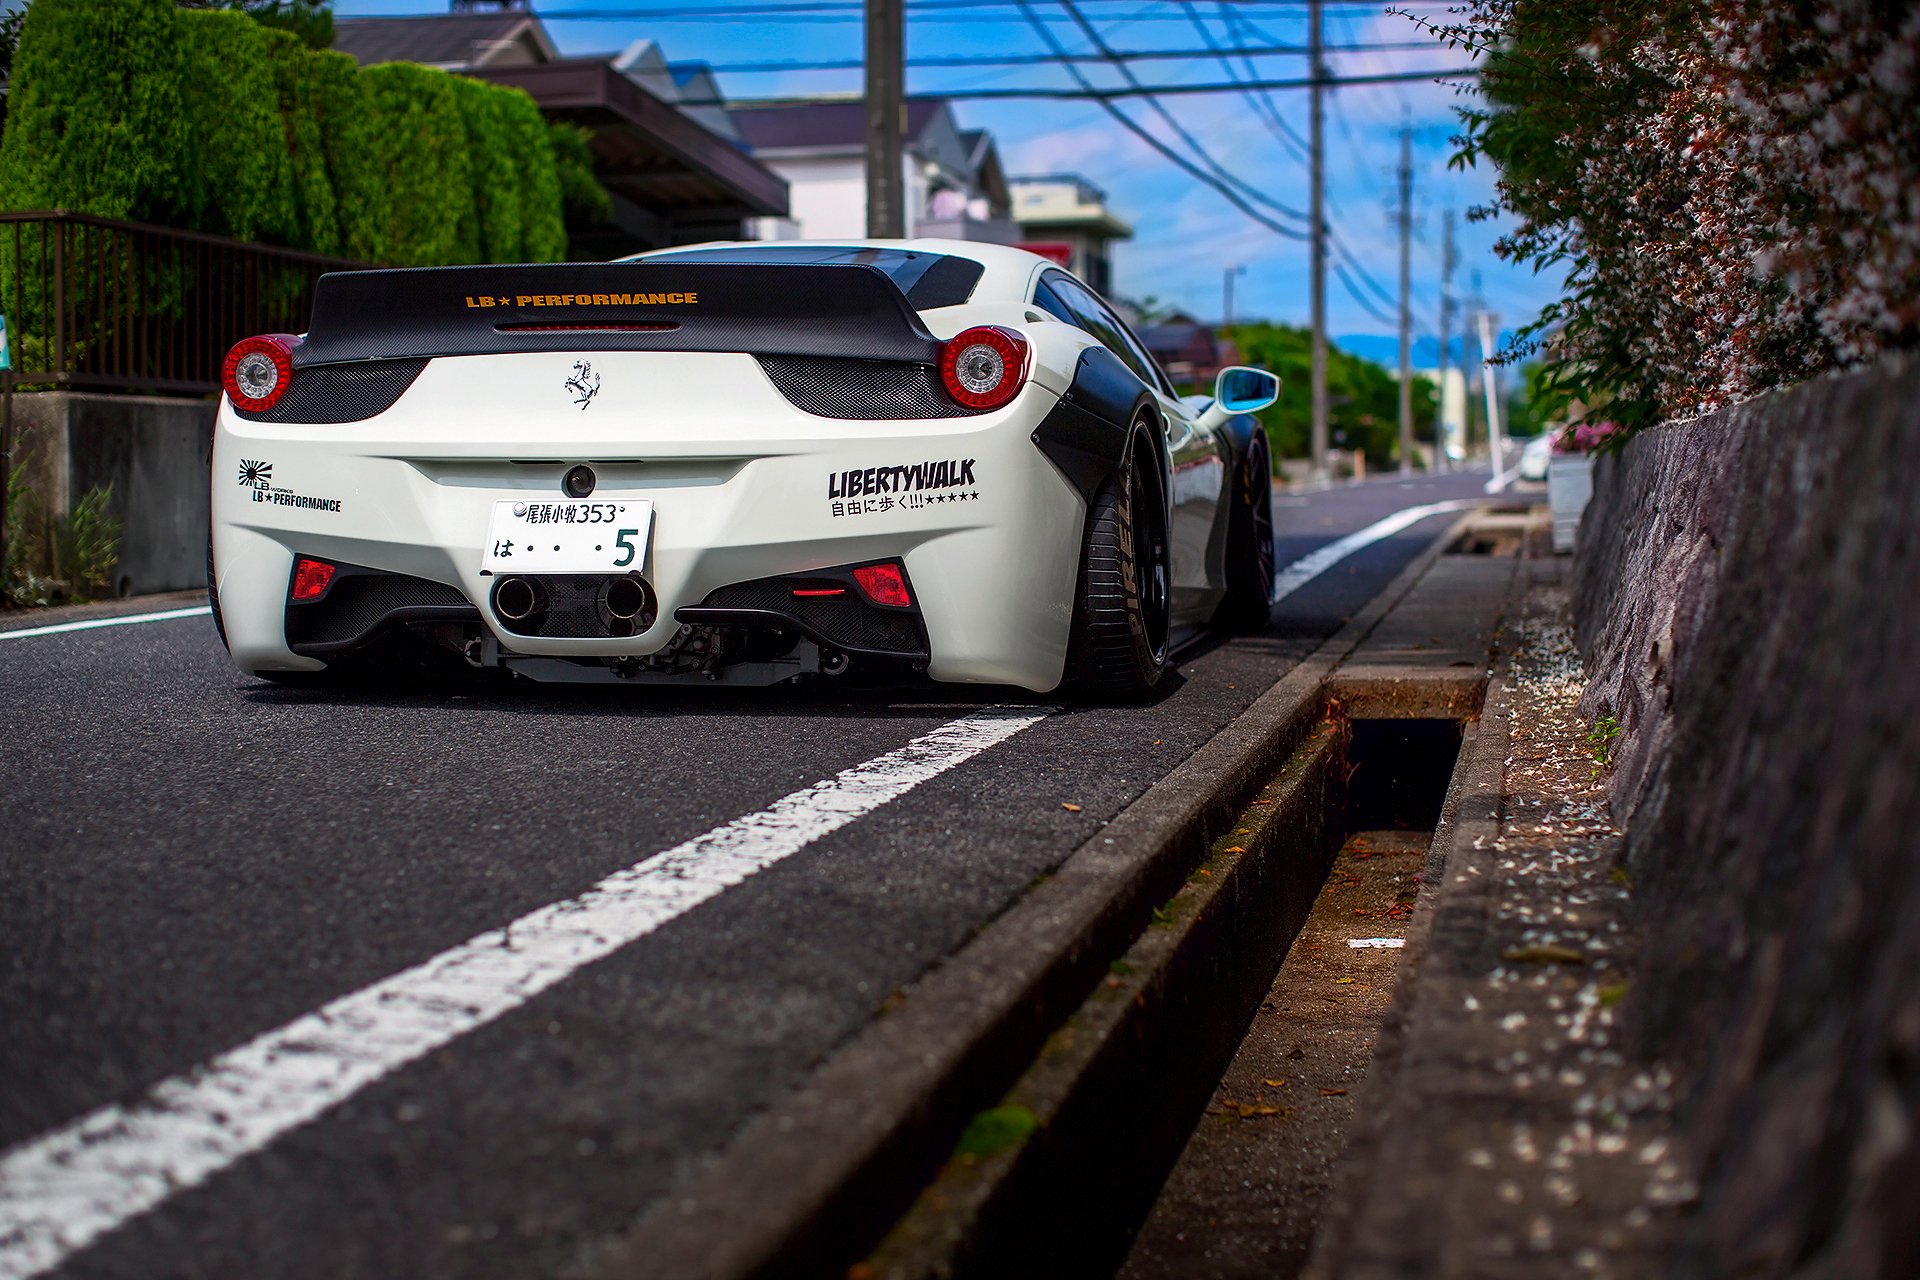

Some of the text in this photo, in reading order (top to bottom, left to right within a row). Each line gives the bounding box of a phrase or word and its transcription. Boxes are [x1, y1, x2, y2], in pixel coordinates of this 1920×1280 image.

[466, 292, 698, 308] LB PERFORMANCE
[253, 481, 270, 491] LB
[828, 458, 976, 500] LIBERTYWALK
[252, 490, 342, 513] LB PERFORMANCE
[493, 528, 639, 567] は 5
